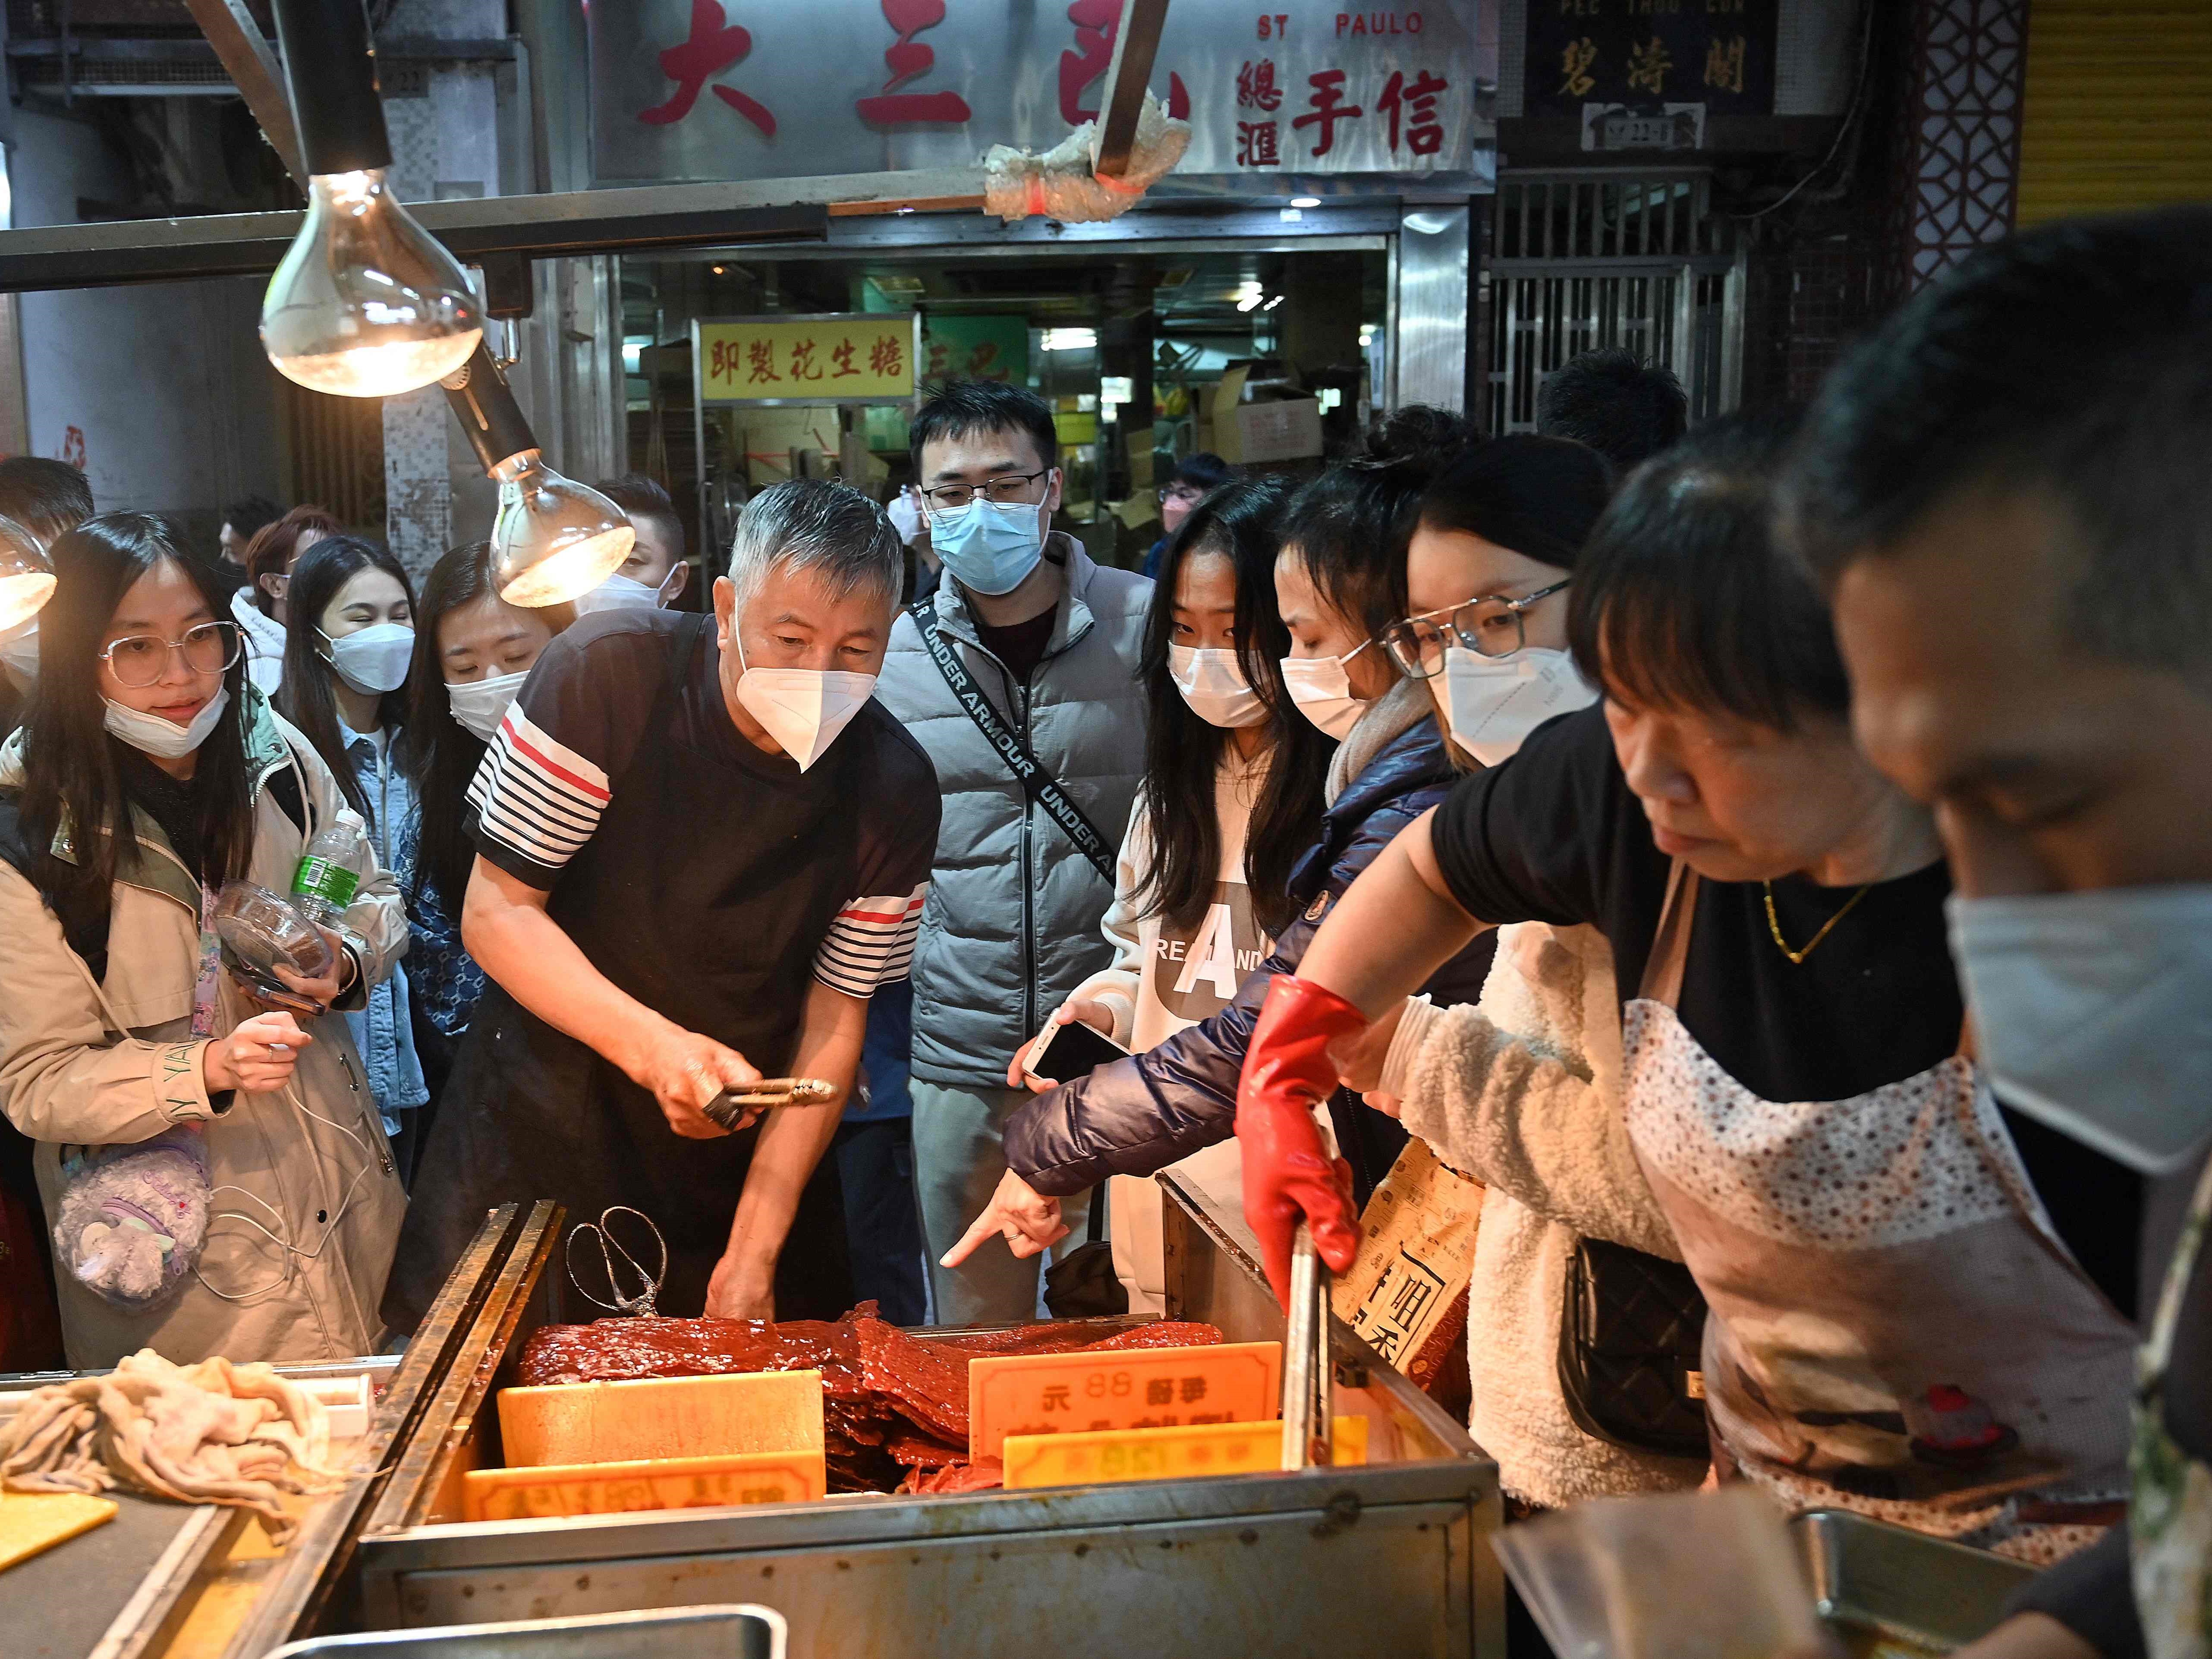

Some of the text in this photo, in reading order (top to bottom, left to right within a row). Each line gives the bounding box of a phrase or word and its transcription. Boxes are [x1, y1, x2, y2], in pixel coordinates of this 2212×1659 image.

[1258, 11, 1423, 40] ST PAULO
[1292, 68, 1447, 156] 手信
[710, 335, 905, 385] 即製花生糖
[924, 623, 968, 691] UNDER
[962, 692, 1035, 778] ARMOUR
[1039, 784, 1100, 854] UNDER
